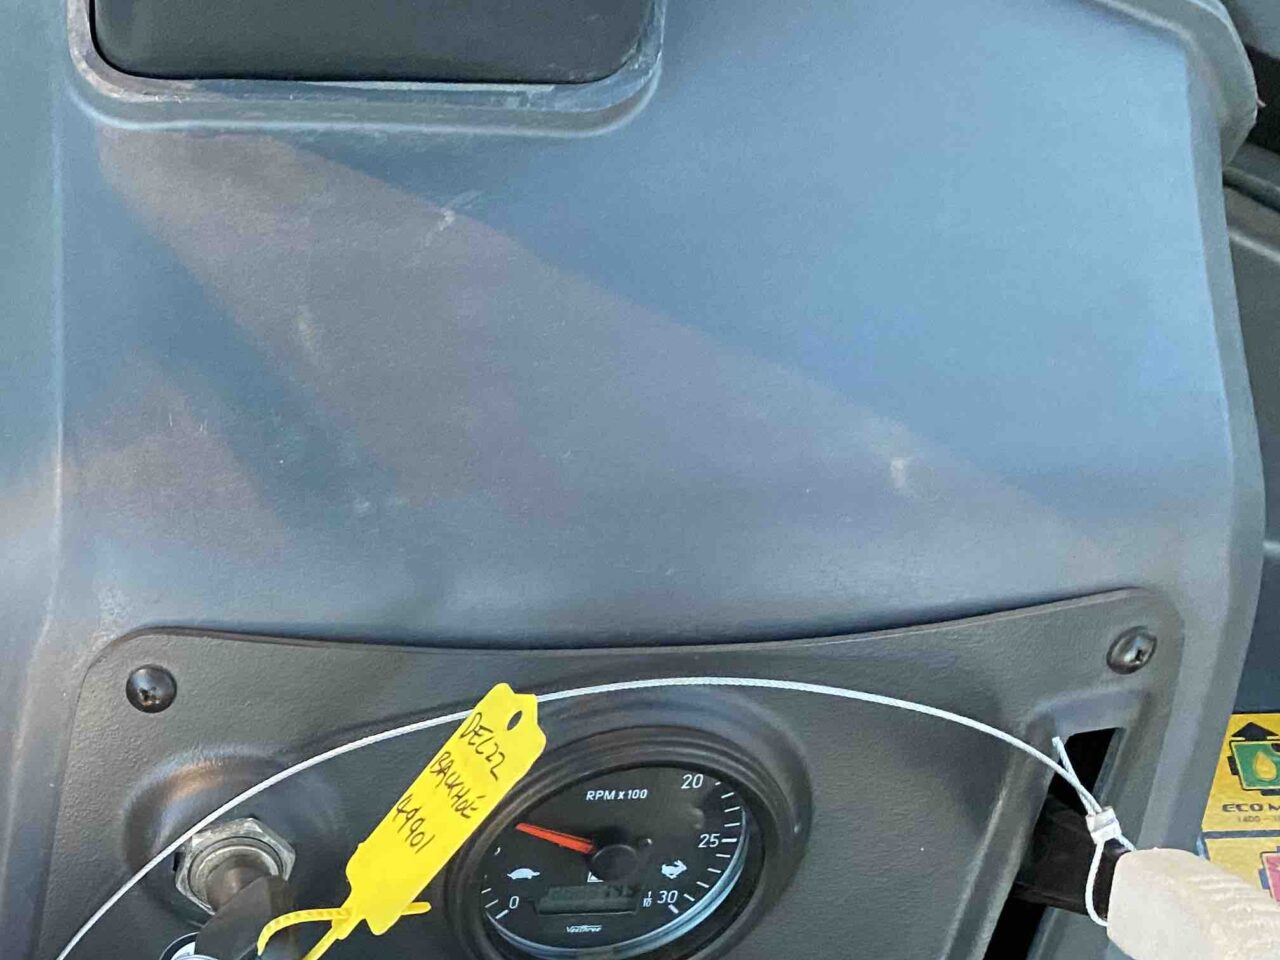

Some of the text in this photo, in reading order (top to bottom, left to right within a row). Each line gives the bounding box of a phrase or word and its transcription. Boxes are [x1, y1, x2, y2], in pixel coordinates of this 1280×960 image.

[681, 774, 703, 789] 20
[586, 790, 615, 800] RPM
[627, 789, 647, 799] 100
[1222, 803, 1264, 812] ECO
[698, 834, 719, 848] 25
[509, 896, 519, 909] 0
[657, 890, 677, 904] 30
